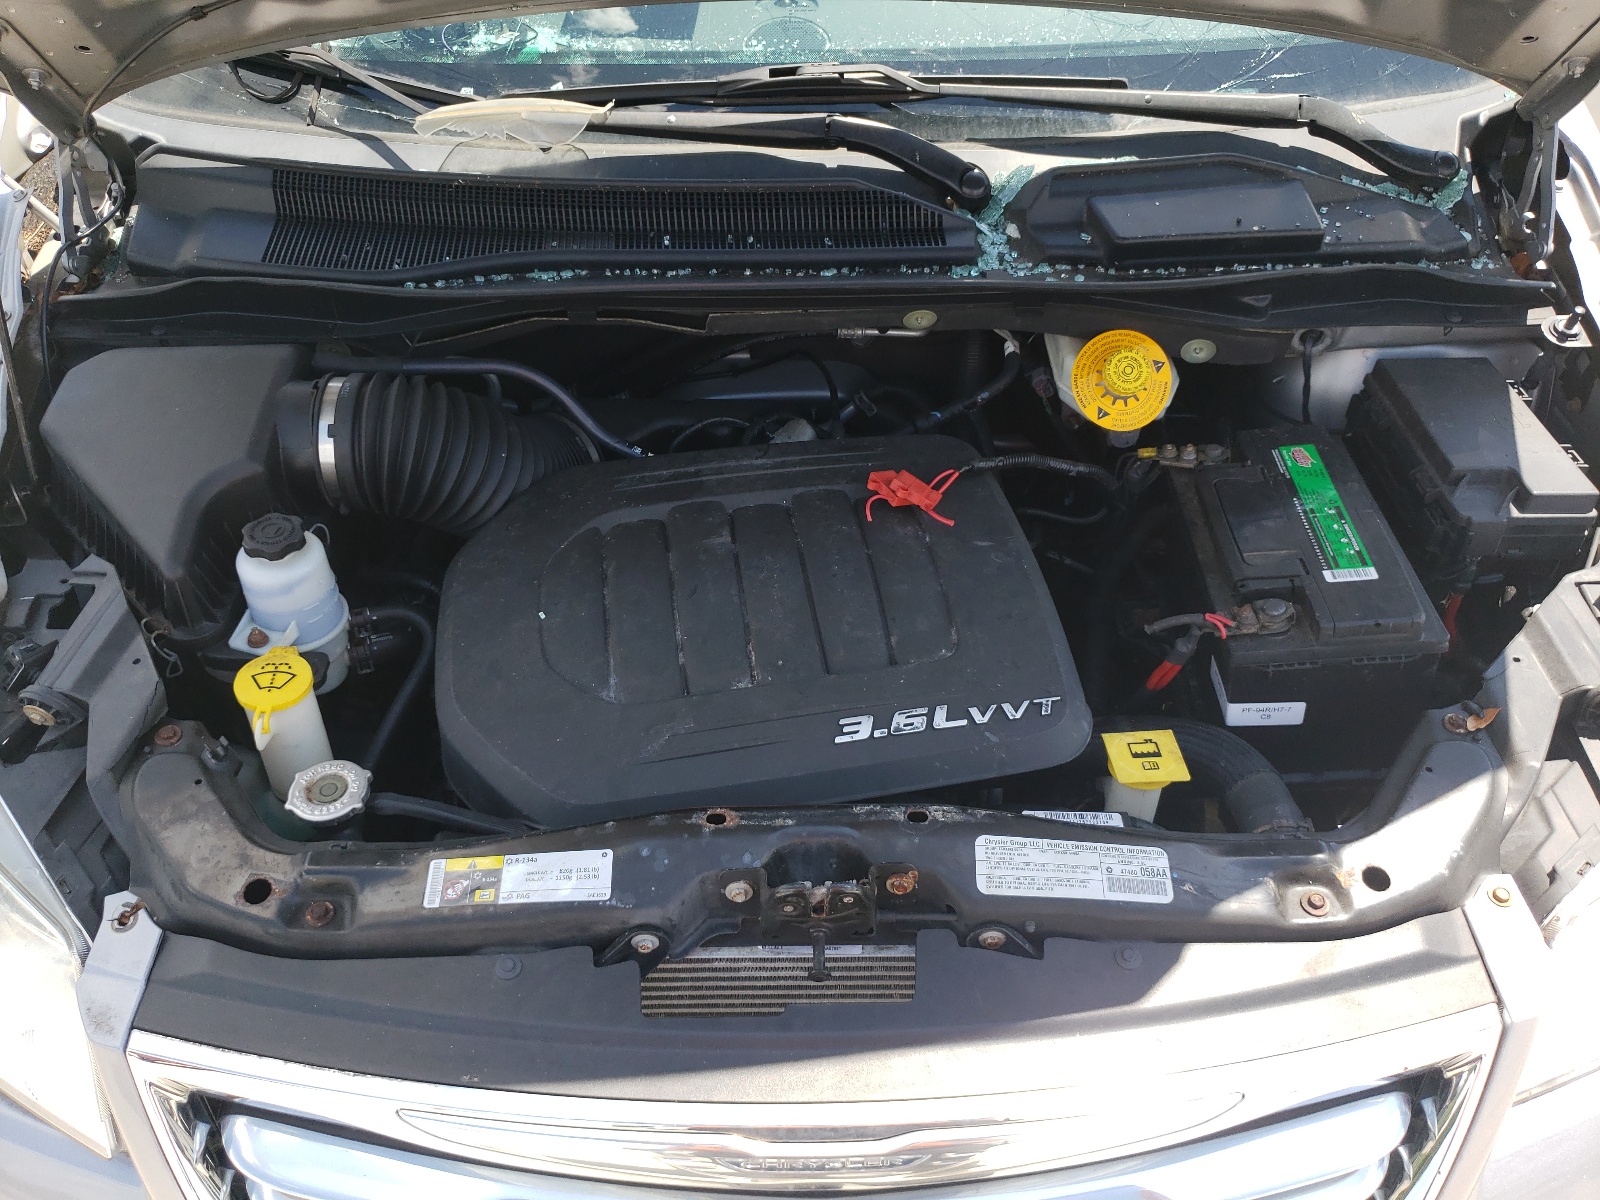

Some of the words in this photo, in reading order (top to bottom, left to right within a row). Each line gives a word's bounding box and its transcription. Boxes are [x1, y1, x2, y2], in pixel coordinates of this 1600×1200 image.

[984, 837, 1009, 846] Chrysler
[1010, 839, 1028, 848] Group
[1046, 841, 1070, 850] VEHICLE
[1071, 843, 1098, 852] EMISSION
[1099, 845, 1125, 854] CONTROL
[1126, 847, 1165, 857] INFORMATION
[514, 856, 538, 864] R-134a
[1140, 866, 1168, 878] 058AA
[516, 892, 531, 900] PAG
